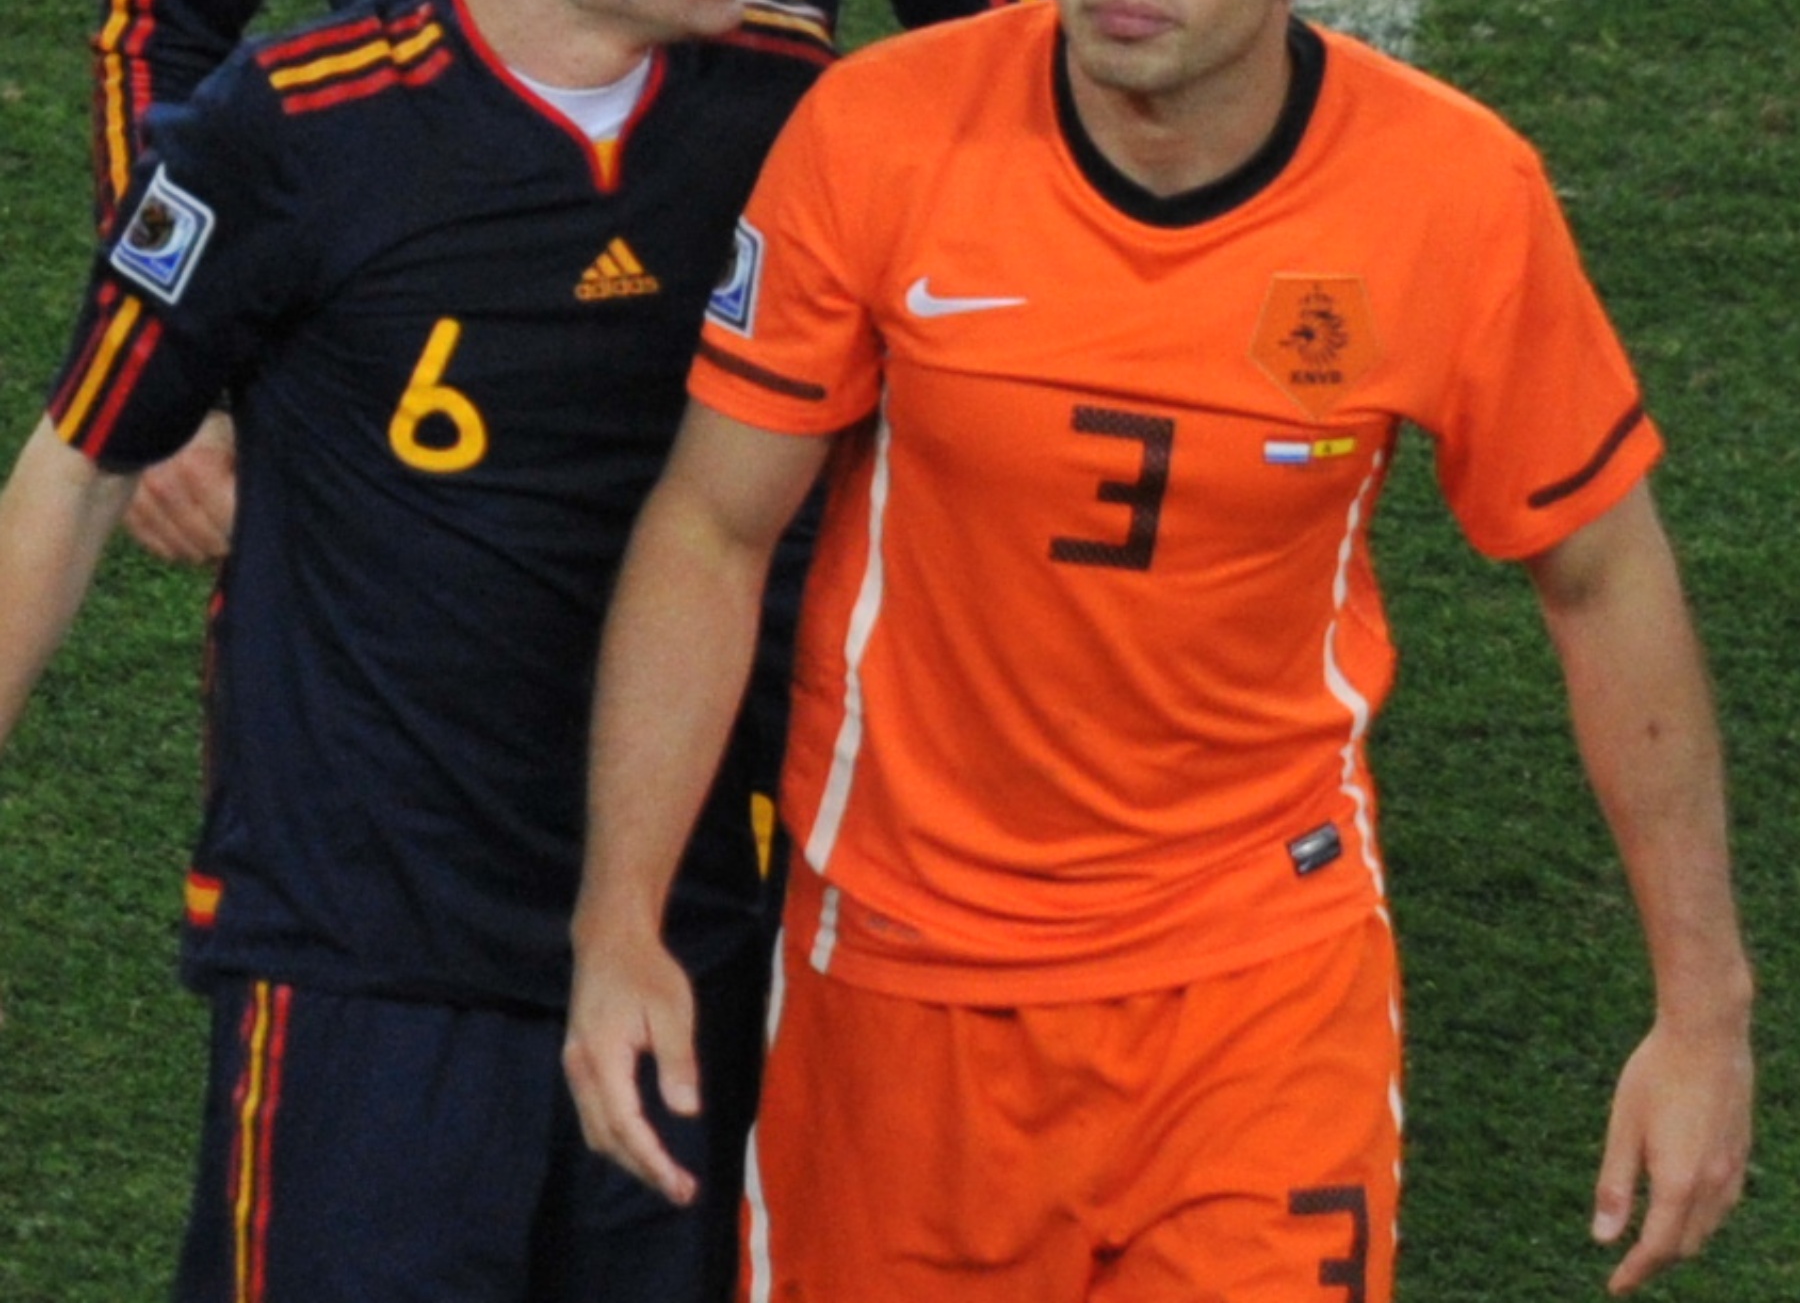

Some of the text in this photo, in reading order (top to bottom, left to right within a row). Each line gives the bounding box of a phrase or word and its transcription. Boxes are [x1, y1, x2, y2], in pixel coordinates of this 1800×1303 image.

[389, 317, 486, 473] 6
[1050, 405, 1175, 571] 3
[1287, 1184, 1369, 1303] 3
